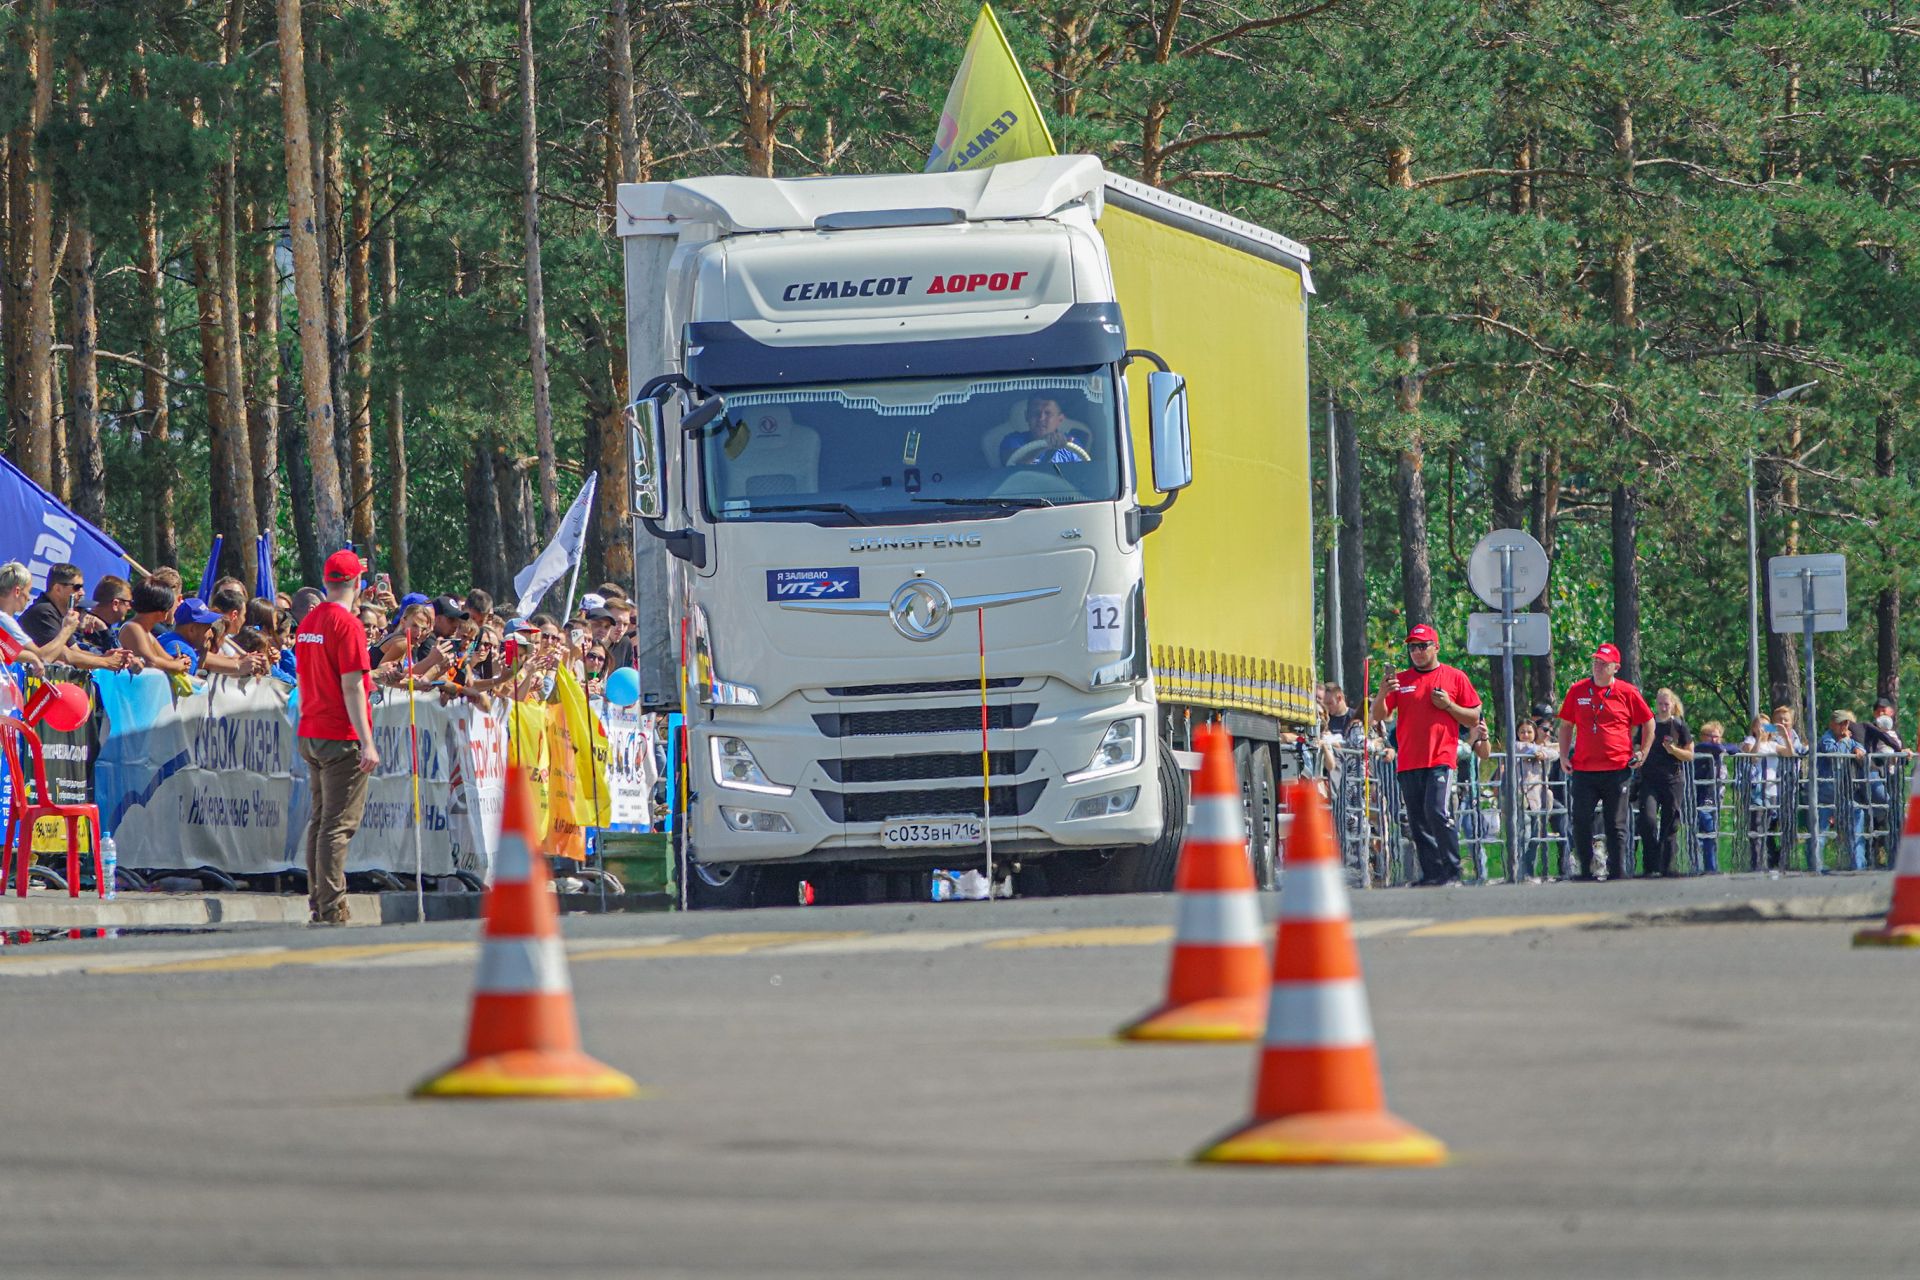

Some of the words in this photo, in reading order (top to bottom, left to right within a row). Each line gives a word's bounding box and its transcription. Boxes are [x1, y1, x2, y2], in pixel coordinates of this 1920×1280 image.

[783, 276, 913, 302] СЕМЬСОТ
[926, 271, 1029, 295] ДОРОГ
[849, 531, 983, 553] DONGFENG
[776, 572, 784, 581] Я
[785, 571, 829, 581] ЗАЛИВАЮ
[1092, 606, 1120, 630] 12
[194, 715, 240, 769] КУБОК
[242, 717, 282, 773] МЭРА
